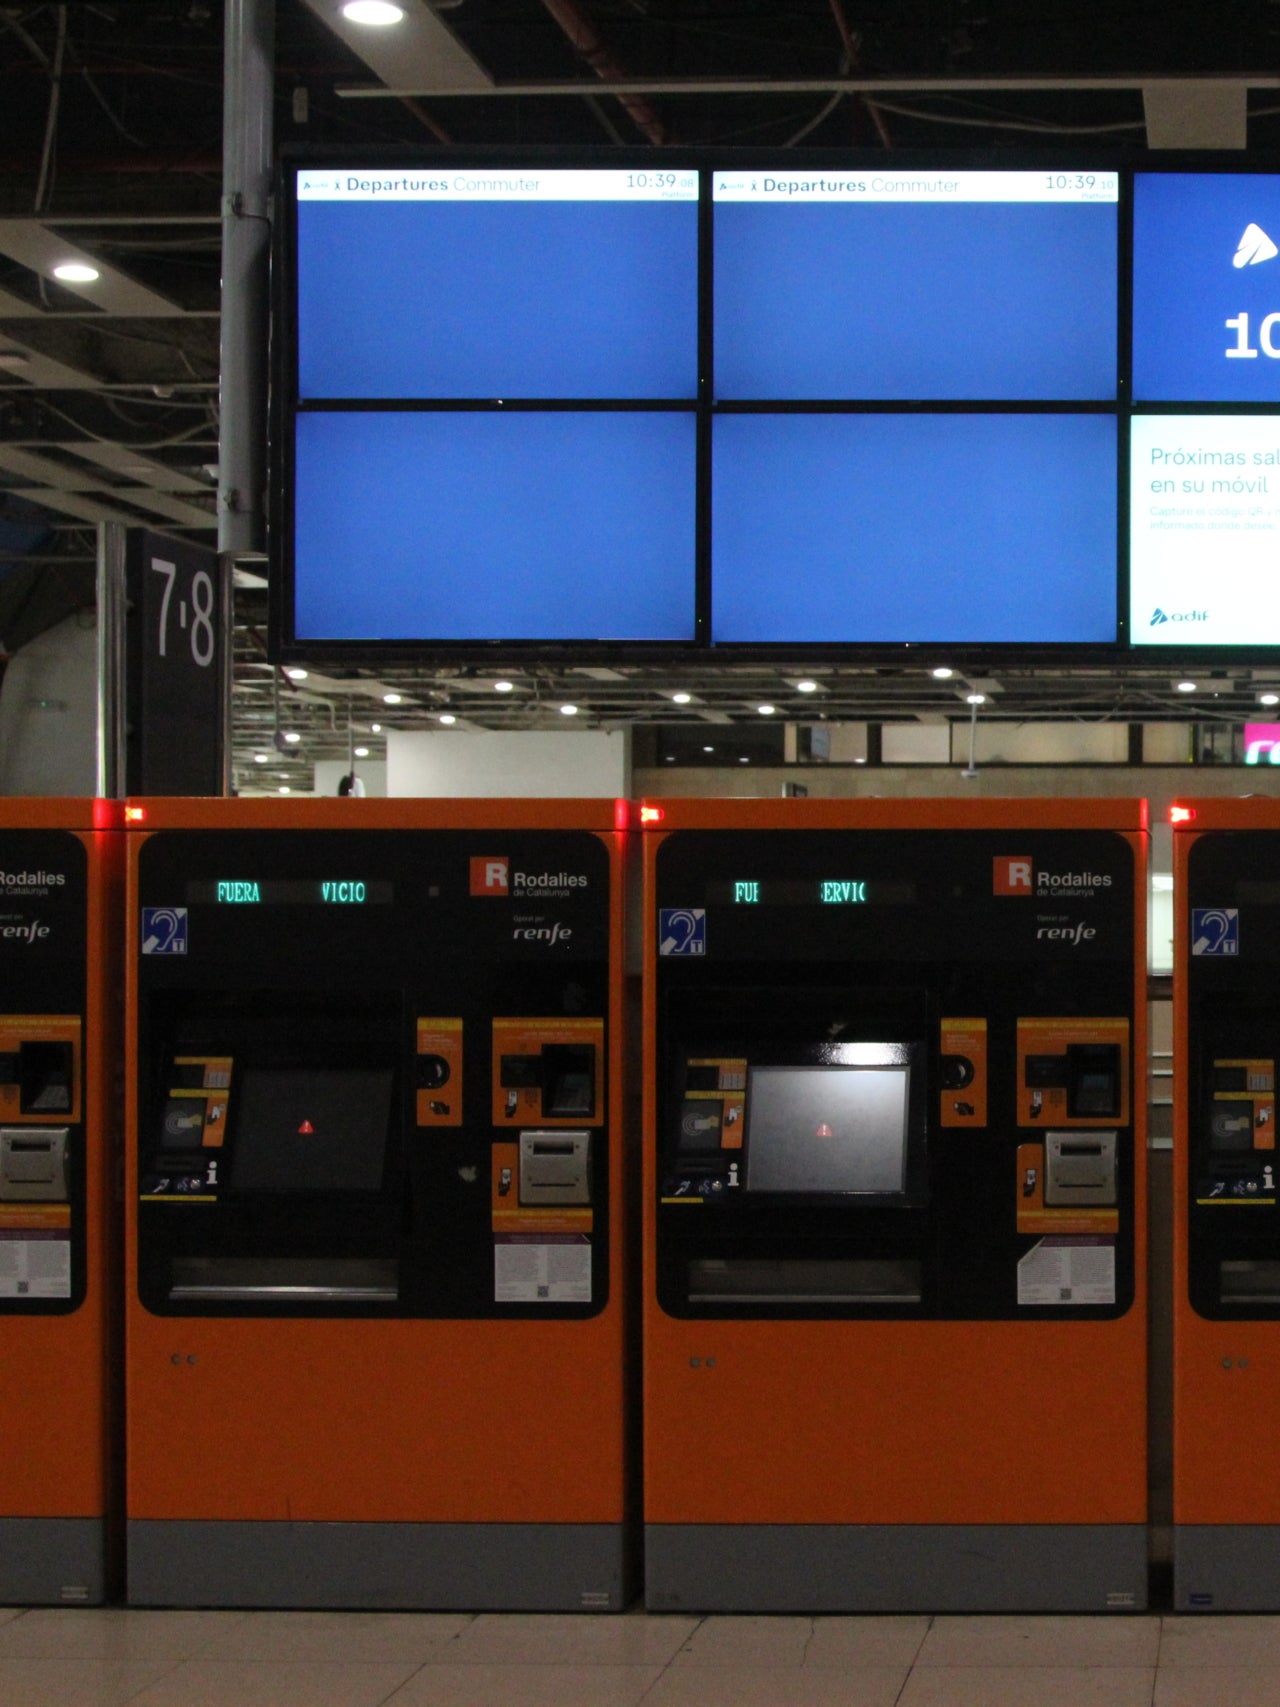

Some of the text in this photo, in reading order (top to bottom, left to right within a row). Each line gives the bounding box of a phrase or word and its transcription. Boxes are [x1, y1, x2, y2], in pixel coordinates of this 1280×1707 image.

[346, 176, 449, 194] Departures
[453, 177, 542, 192] Commuter
[763, 178, 866, 196] Departures
[870, 178, 960, 193] Commuter
[1150, 447, 1247, 466] Próximas
[1150, 476, 1269, 494] en su móvil
[1171, 610, 1210, 622] adif
[514, 872, 588, 887] Rodalies
[1037, 872, 1112, 886] Rodalies
[6, 886, 49, 896] Catalunya
[218, 882, 366, 902] FUERA VICIO
[513, 888, 570, 898] de Catalunya
[820, 882, 865, 902] ERVIC
[1036, 888, 1094, 898] de Catalunya
[513, 922, 572, 946] renfe
[1036, 922, 1096, 946] renfe
